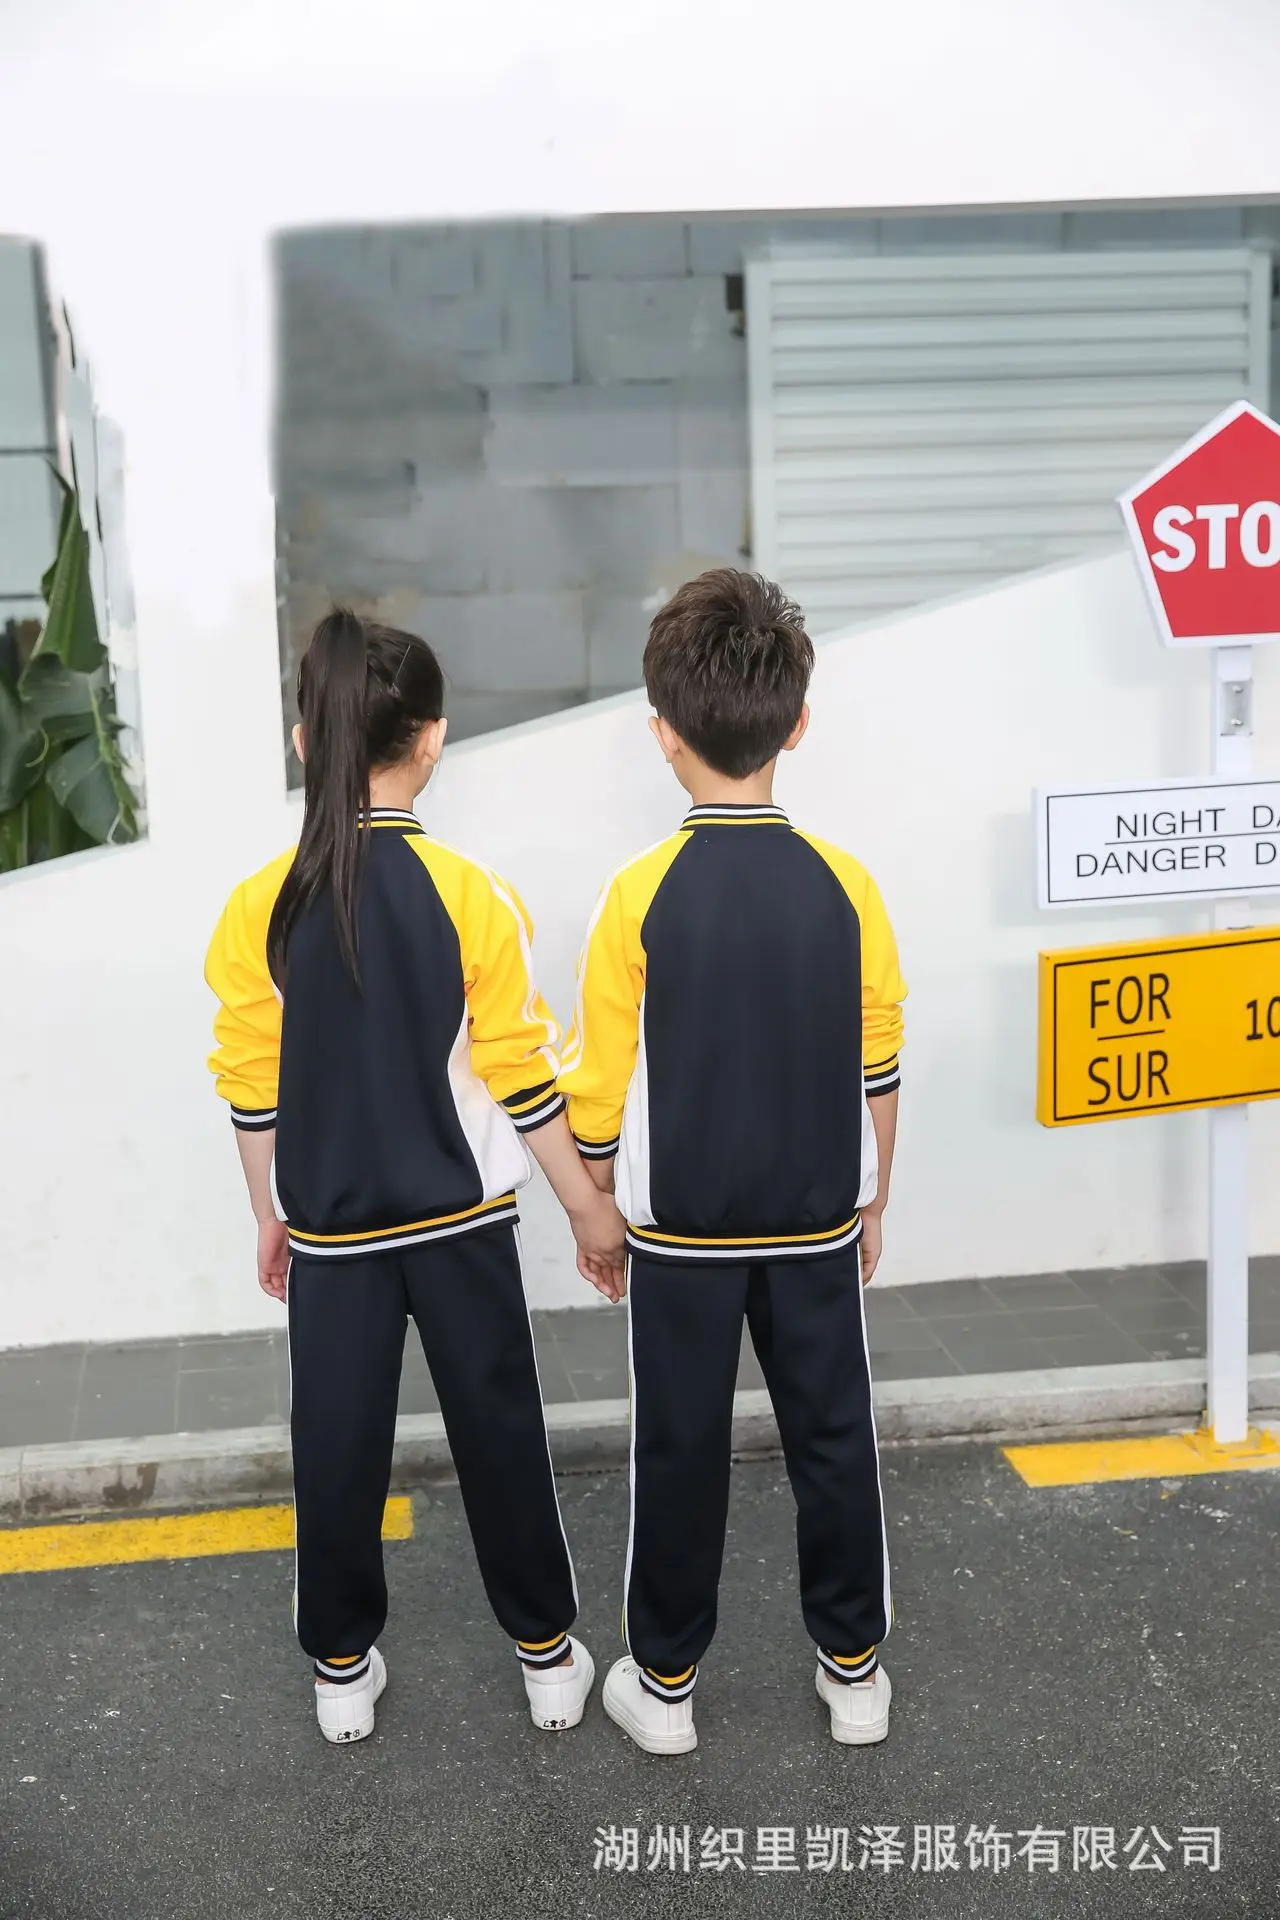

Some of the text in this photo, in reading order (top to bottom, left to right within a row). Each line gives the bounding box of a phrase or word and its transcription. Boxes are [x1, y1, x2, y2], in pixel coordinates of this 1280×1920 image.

[1117, 805, 1280, 838] NIGHT D
[1076, 844, 1226, 877] DANGER
[1090, 972, 1171, 1029] FOR
[1088, 1050, 1170, 1106] SUR
